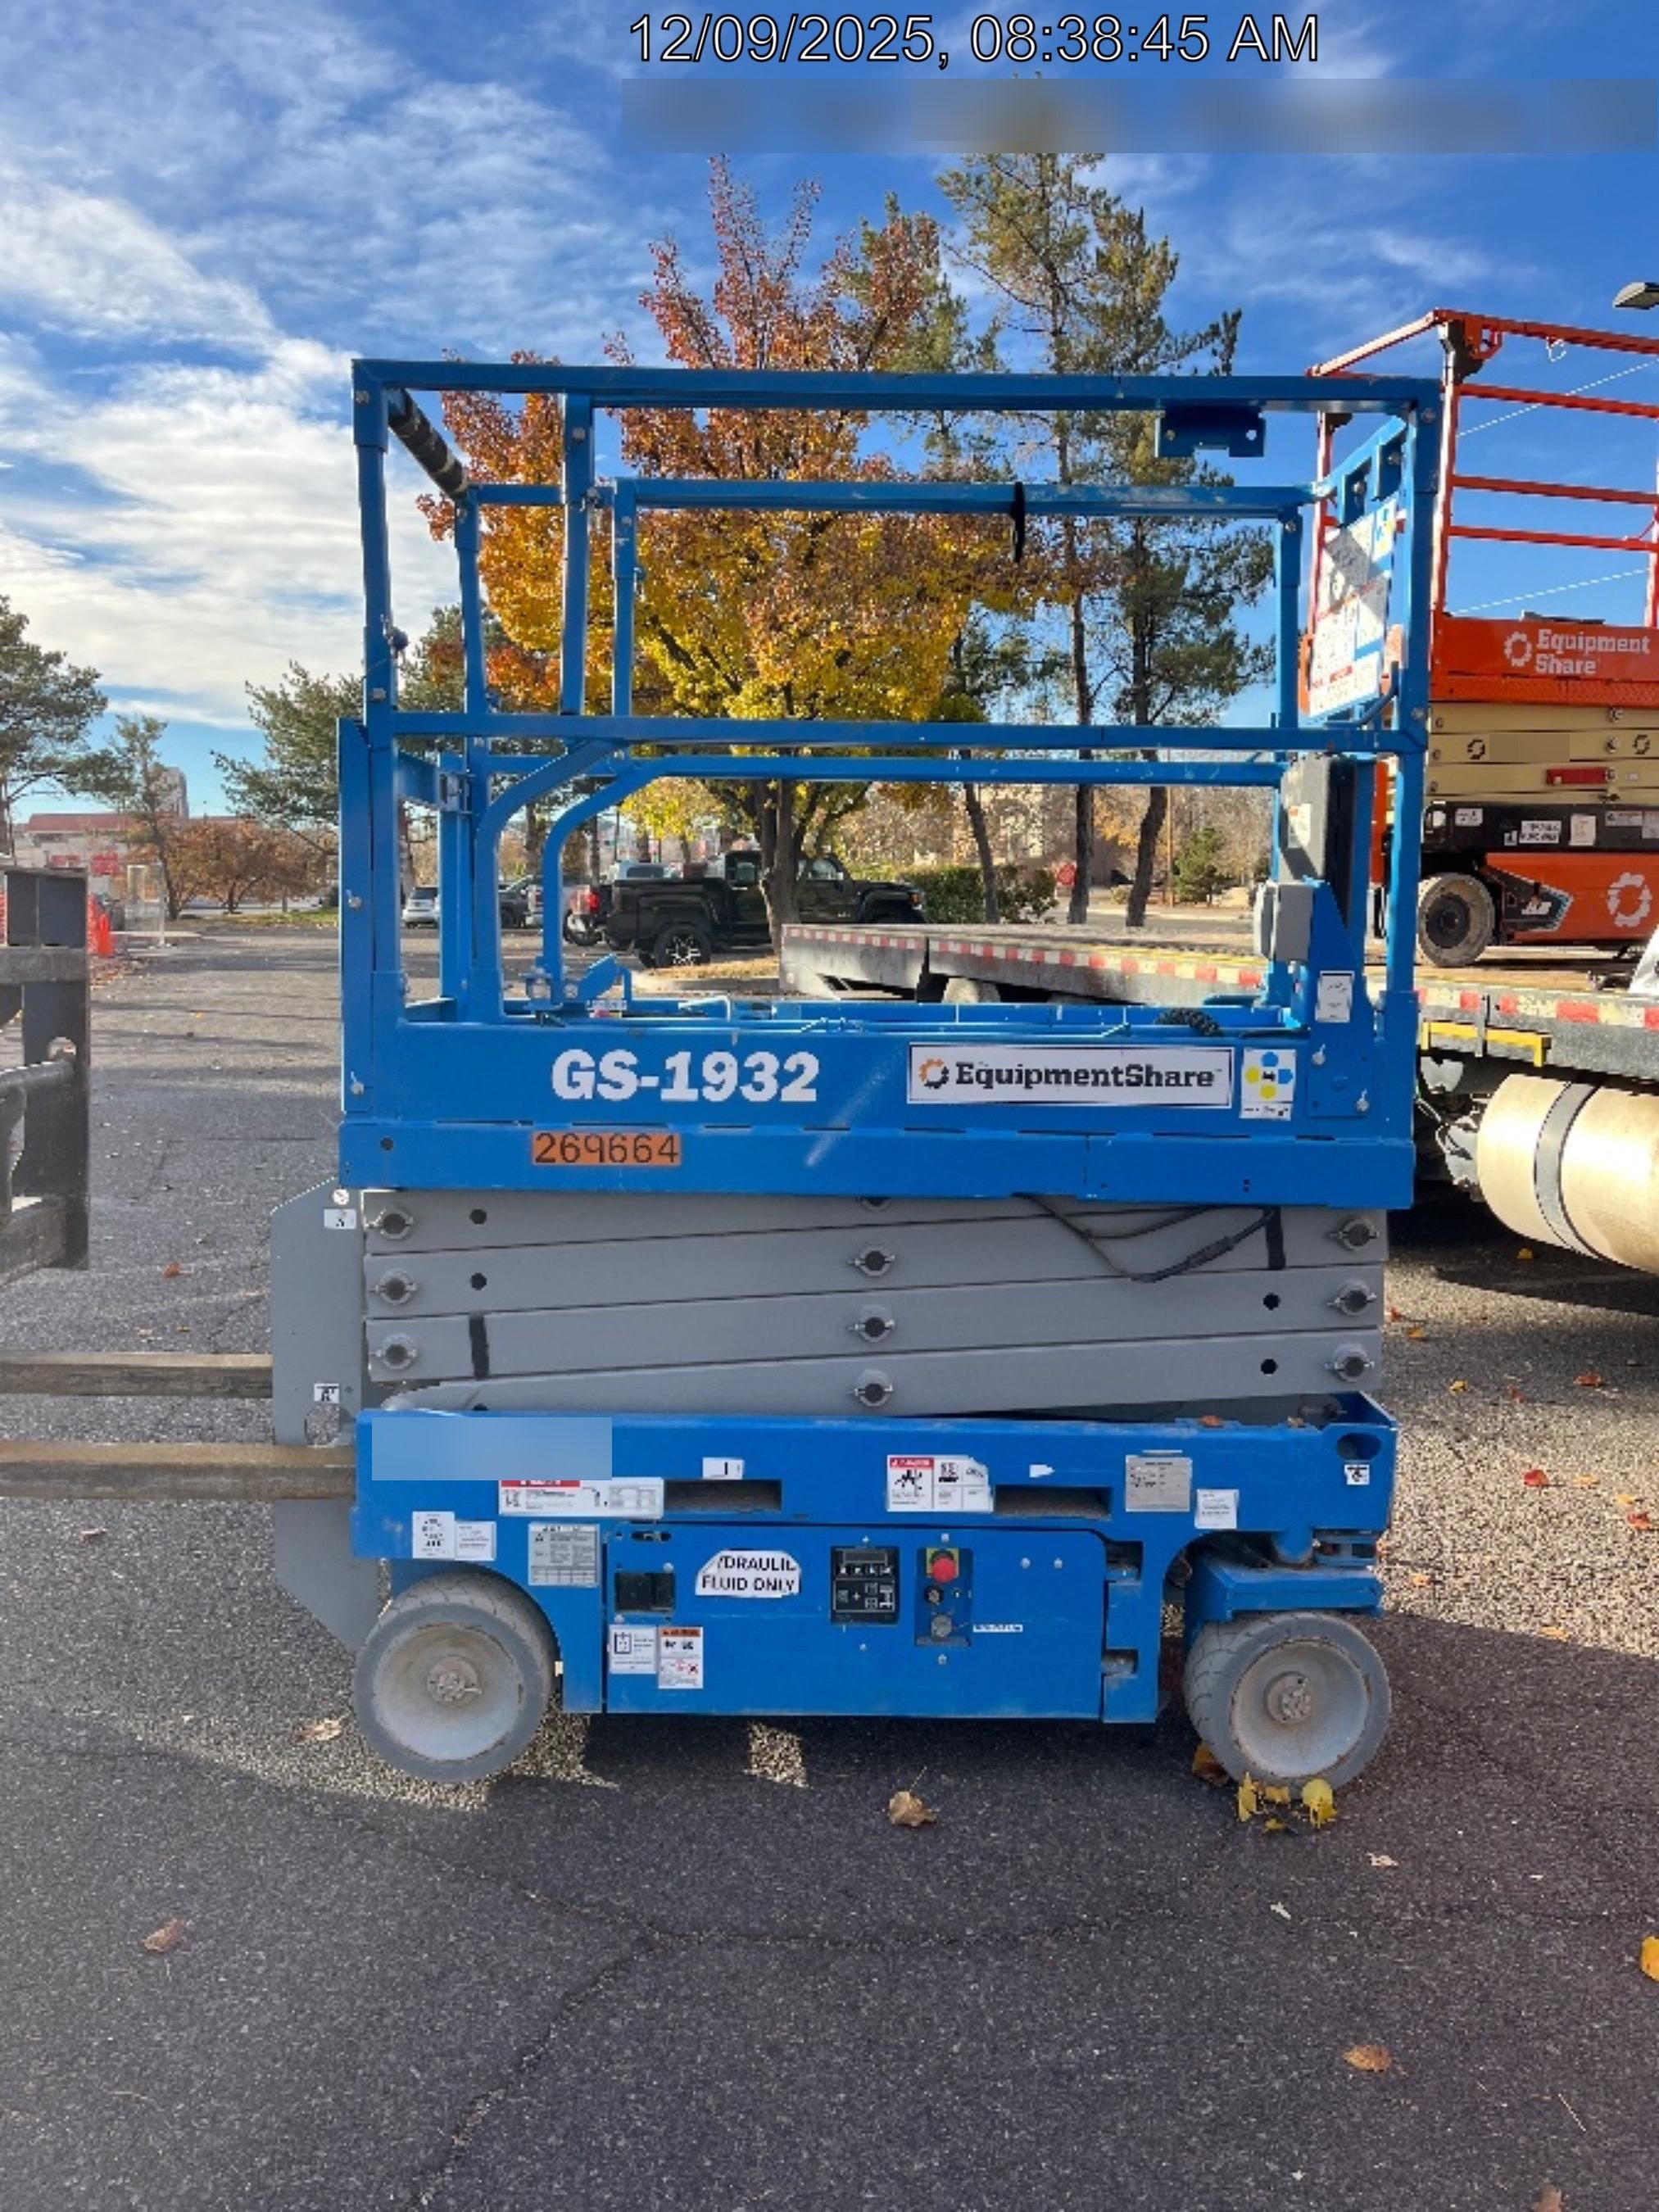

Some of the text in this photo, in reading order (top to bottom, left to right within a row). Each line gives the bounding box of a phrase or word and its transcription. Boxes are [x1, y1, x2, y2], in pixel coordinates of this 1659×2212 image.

[1536, 628, 1650, 655] Equipment
[1534, 653, 1597, 674] Share
[552, 1049, 819, 1101] GS-1932
[956, 1062, 1215, 1090] EquipmentShare
[535, 1132, 679, 1163] 269664
[702, 1575, 795, 1591] FLUID ONLY
